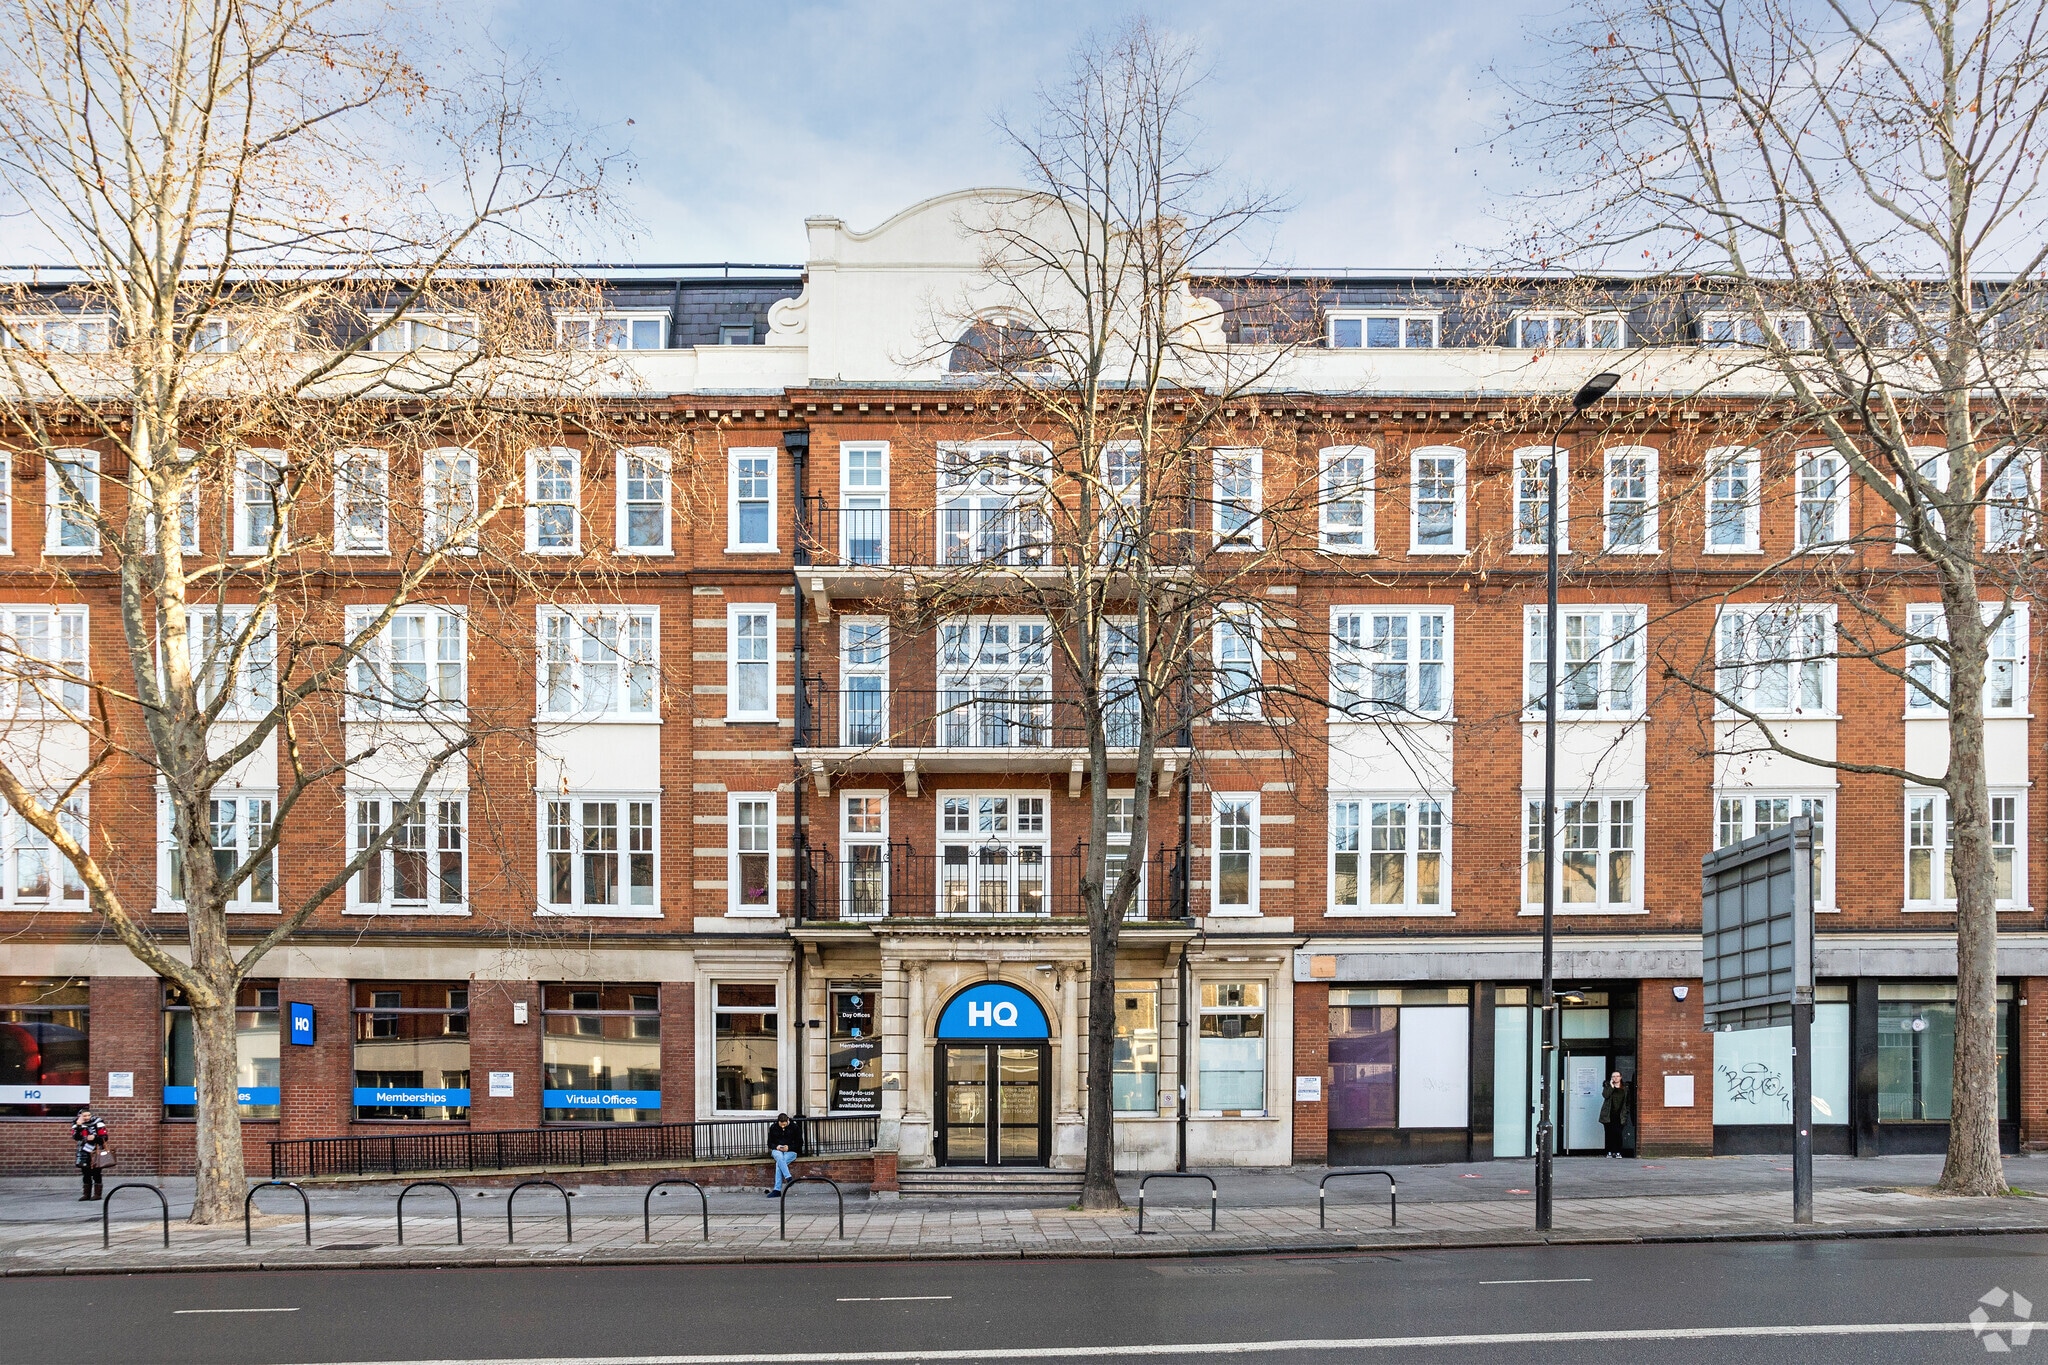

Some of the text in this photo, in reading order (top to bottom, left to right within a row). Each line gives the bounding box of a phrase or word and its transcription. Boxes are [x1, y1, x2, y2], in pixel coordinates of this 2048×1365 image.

[968, 1001, 1018, 1027] HQ
[295, 1016, 310, 1032] HQ
[24, 1089, 42, 1099] HQ
[376, 1092, 447, 1104] Memberships
[565, 1094, 638, 1105] Virtual Offices
